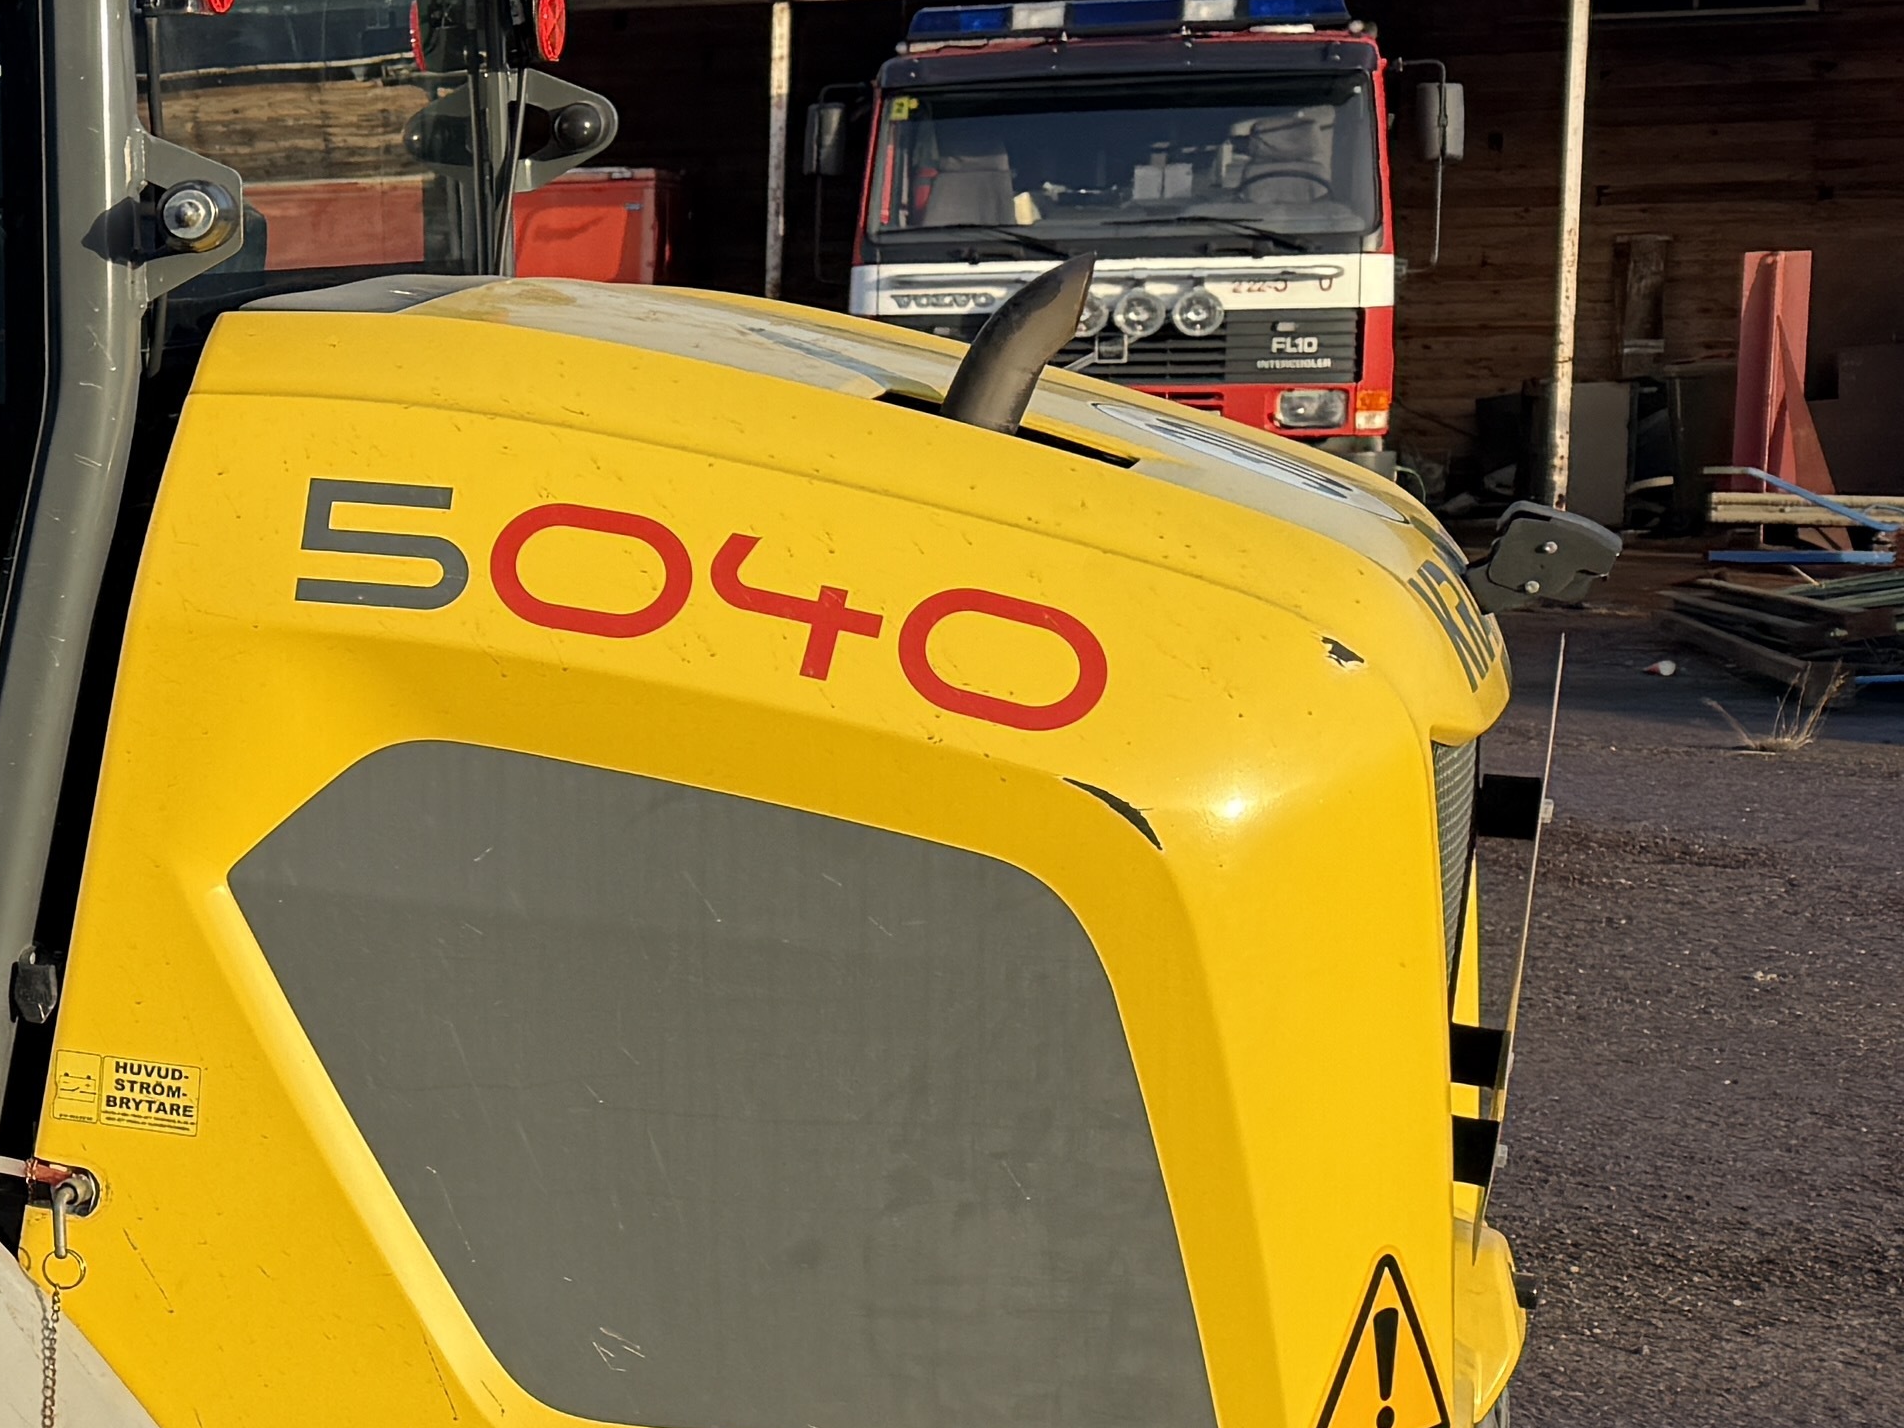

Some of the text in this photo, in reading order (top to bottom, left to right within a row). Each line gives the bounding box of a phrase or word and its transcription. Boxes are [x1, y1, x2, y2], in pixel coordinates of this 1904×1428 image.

[890, 291, 994, 309] VOLVO
[1271, 336, 1319, 354] FL10
[1256, 357, 1332, 370] INTERCOOLER
[295, 477, 1108, 731] 5040
[115, 1060, 189, 1081] HUVUD-
[114, 1078, 188, 1099] STRÖM-
[105, 1094, 194, 1118] BRYTARE
